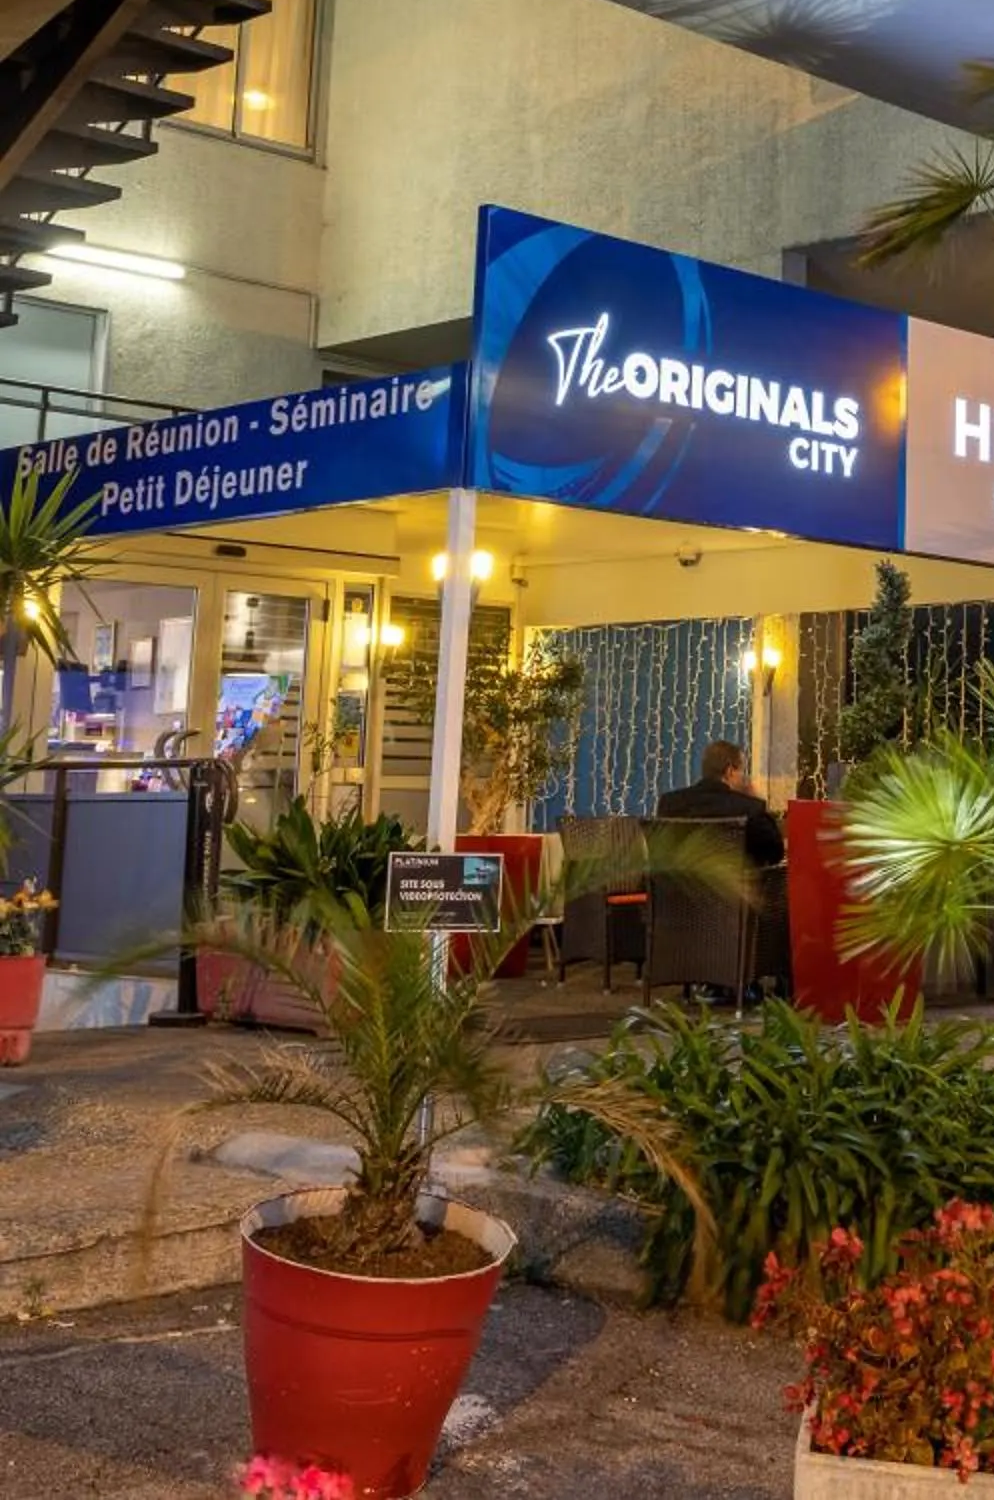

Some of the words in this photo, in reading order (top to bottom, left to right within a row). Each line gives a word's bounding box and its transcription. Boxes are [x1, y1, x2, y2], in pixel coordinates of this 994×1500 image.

[18, 438, 78, 478] Salle
[87, 434, 117, 467] de
[126, 412, 239, 461] Réunion
[269, 376, 434, 437] Séminaire
[788, 437, 860, 479] CITY
[101, 474, 165, 517] Petit
[174, 458, 310, 511] Déjeuner
[400, 879, 419, 889] SITE
